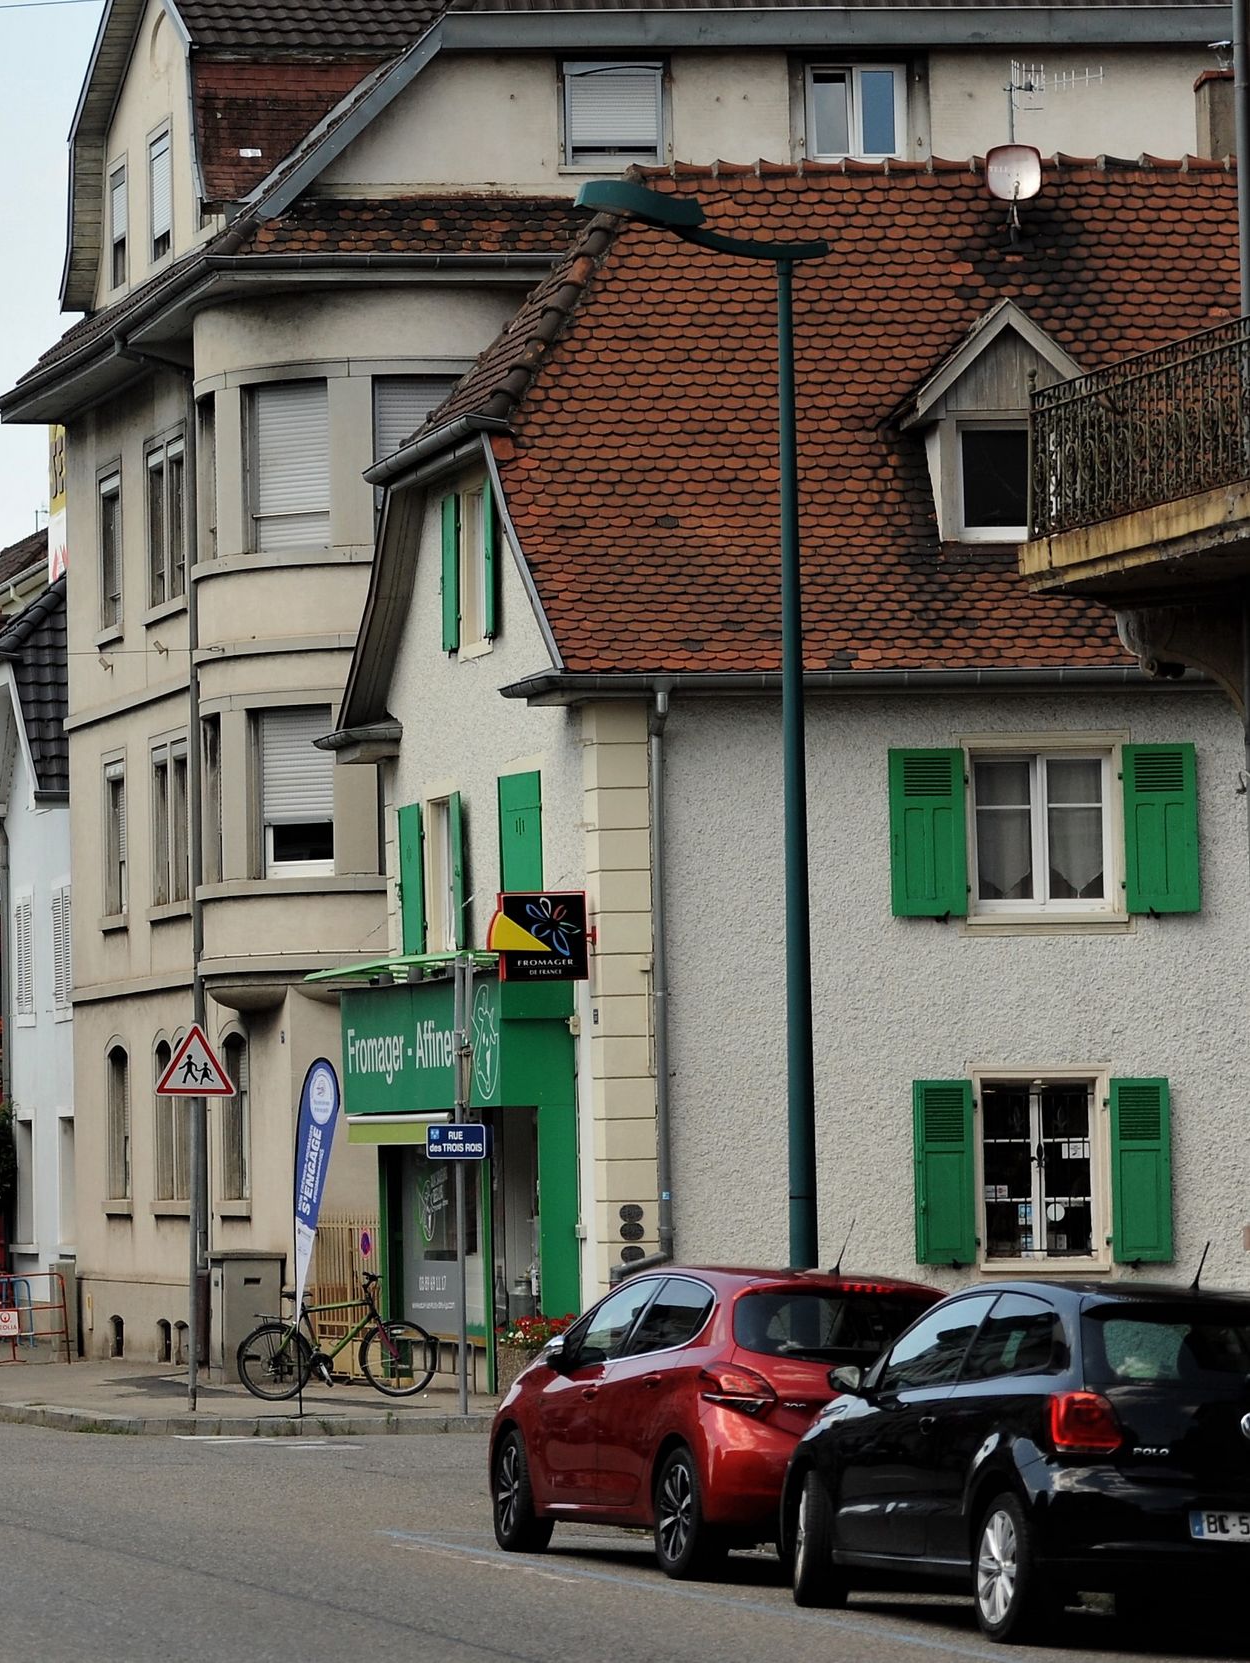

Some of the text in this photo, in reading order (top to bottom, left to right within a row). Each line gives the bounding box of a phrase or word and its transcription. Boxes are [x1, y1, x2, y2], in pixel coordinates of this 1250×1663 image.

[347, 1028, 405, 1085] Fromager
[415, 1020, 466, 1069] Affine
[448, 1131, 464, 1140] RUE
[429, 1143, 483, 1152] des TROIS ROIS
[1133, 1447, 1170, 1456] POLO
